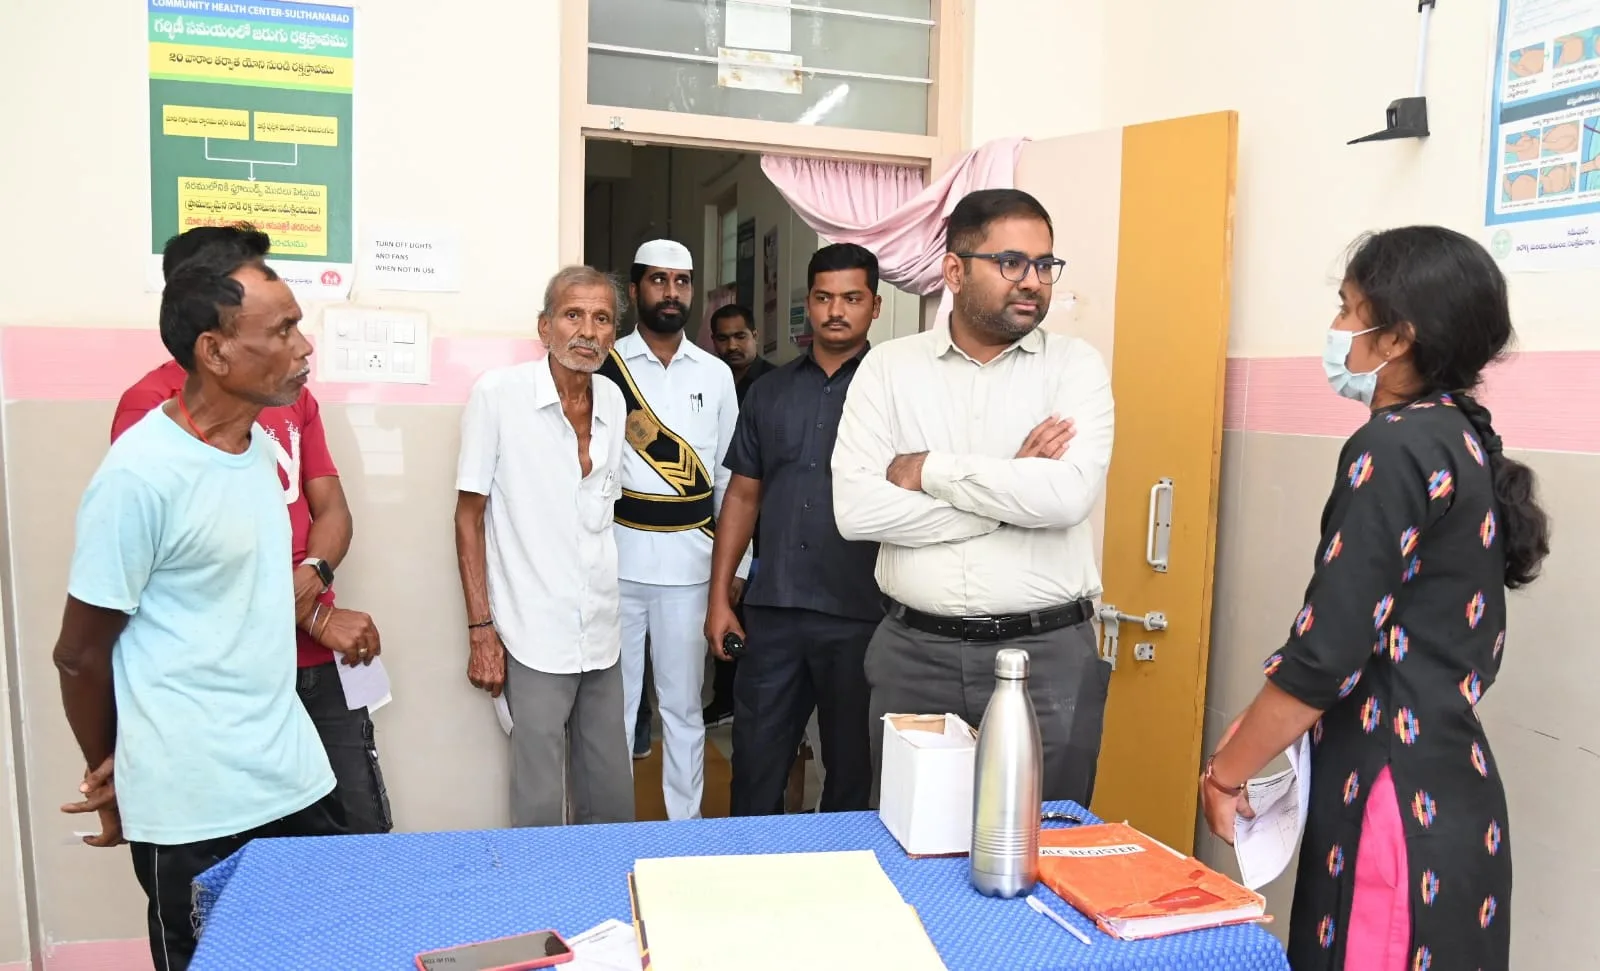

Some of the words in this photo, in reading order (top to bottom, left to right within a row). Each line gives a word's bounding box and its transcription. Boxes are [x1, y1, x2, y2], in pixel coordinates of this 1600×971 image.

[152, 0, 210, 11] COMMUNITY
[211, 2, 246, 14] HEALTH
[248, 6, 350, 23] CENTER-SULTHANABAD
[186, 21, 251, 40] సమయంలో
[252, 27, 288, 43] జరుగు
[168, 52, 184, 63] 20
[185, 54, 213, 65] వారాల
[214, 55, 241, 71] తర్వాత
[241, 57, 265, 69] యోని
[266, 60, 291, 71] నుండి
[409, 242, 433, 250] LIGHTS
[375, 265, 396, 273] WHEN
[1068, 846, 1137, 856] REGISTER
